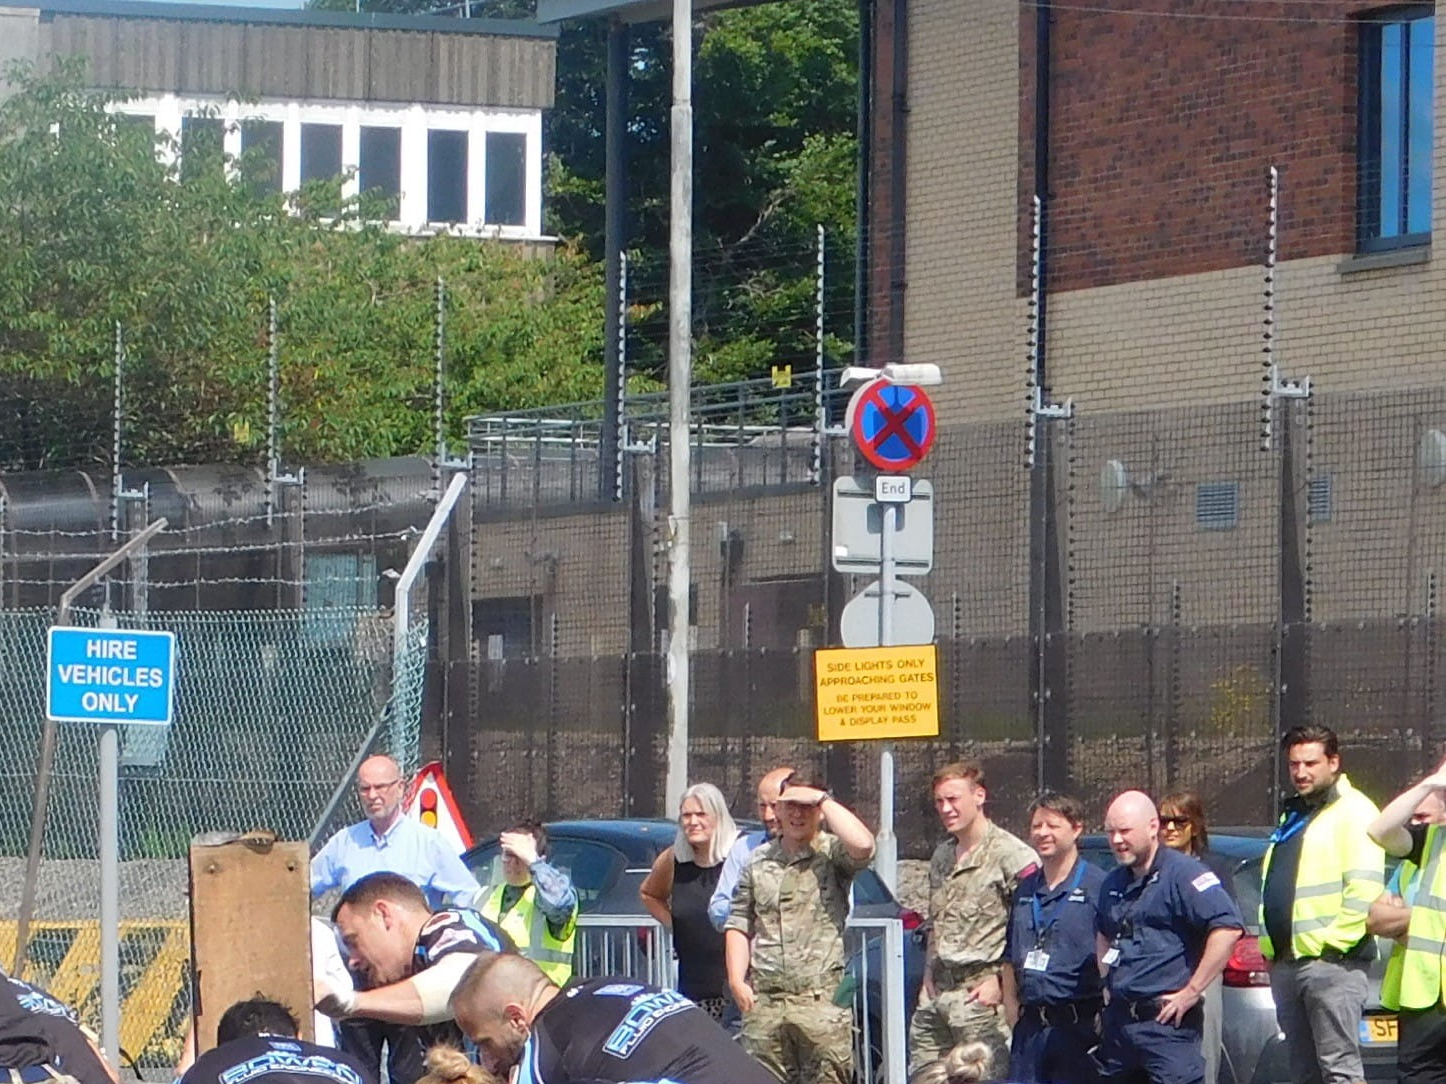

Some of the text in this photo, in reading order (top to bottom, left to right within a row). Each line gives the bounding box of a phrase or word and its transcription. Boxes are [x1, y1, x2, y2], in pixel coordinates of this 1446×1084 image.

[881, 483, 906, 495] End
[86, 639, 138, 660] HIRE
[826, 658, 925, 673] SIDE LIGHTS ONLY
[57, 663, 164, 689] VEHICLES
[820, 672, 935, 687] APPROACHING GATES
[81, 691, 139, 714] ONLY
[852, 692, 902, 702] PREPARED
[905, 691, 918, 700] TO
[823, 702, 932, 716] LOWER YOUR WINDOW
[849, 716, 888, 727] DISPLAY
[892, 714, 918, 724] PASS
